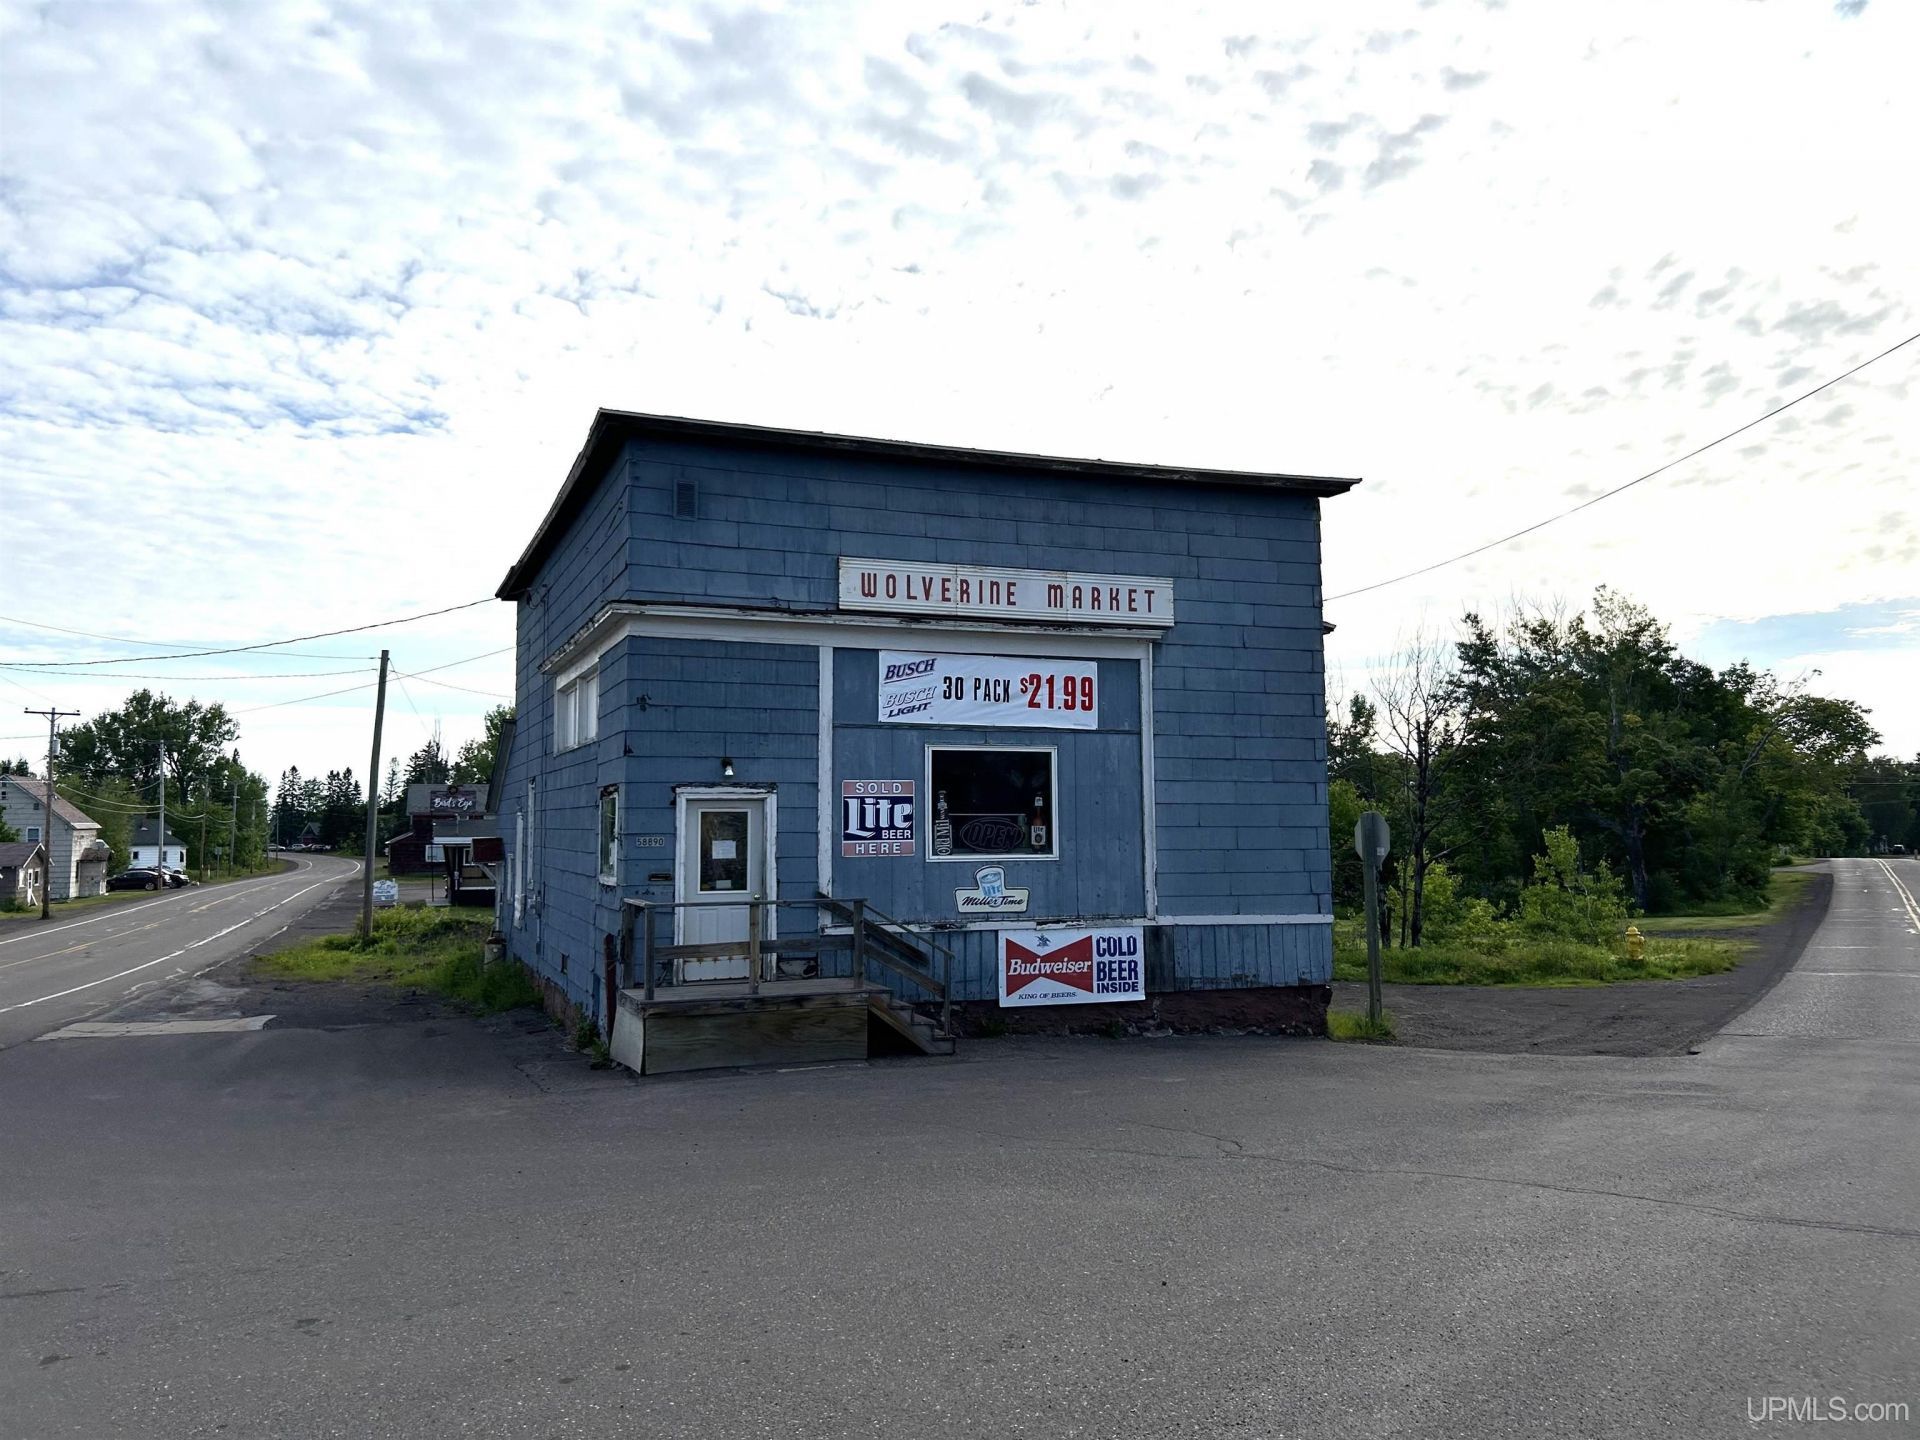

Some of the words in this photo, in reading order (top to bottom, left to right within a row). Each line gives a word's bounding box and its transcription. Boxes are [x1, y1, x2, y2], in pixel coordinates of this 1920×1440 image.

[861, 572, 1017, 606] WOLVERINE
[1047, 584, 1155, 613] MARKET
[884, 658, 937, 681] BUSCH
[883, 686, 937, 708] BUSCH
[943, 676, 964, 700] 30
[973, 678, 1011, 703] PACK
[1020, 674, 1093, 711] $21.99
[887, 702, 931, 718] LIGHT
[855, 782, 902, 793] SOLD
[844, 798, 913, 838] Lite
[636, 837, 664, 847] 58890
[881, 829, 911, 839] BEER
[967, 822, 1018, 848] OPEN
[855, 843, 901, 854] HERE
[961, 896, 999, 906] Miller
[998, 896, 1025, 906] Time
[1096, 935, 1138, 957] COLD
[1008, 957, 1092, 976] Budweiser
[1096, 959, 1139, 982] BEER
[1096, 982, 1139, 994] INSIDE
